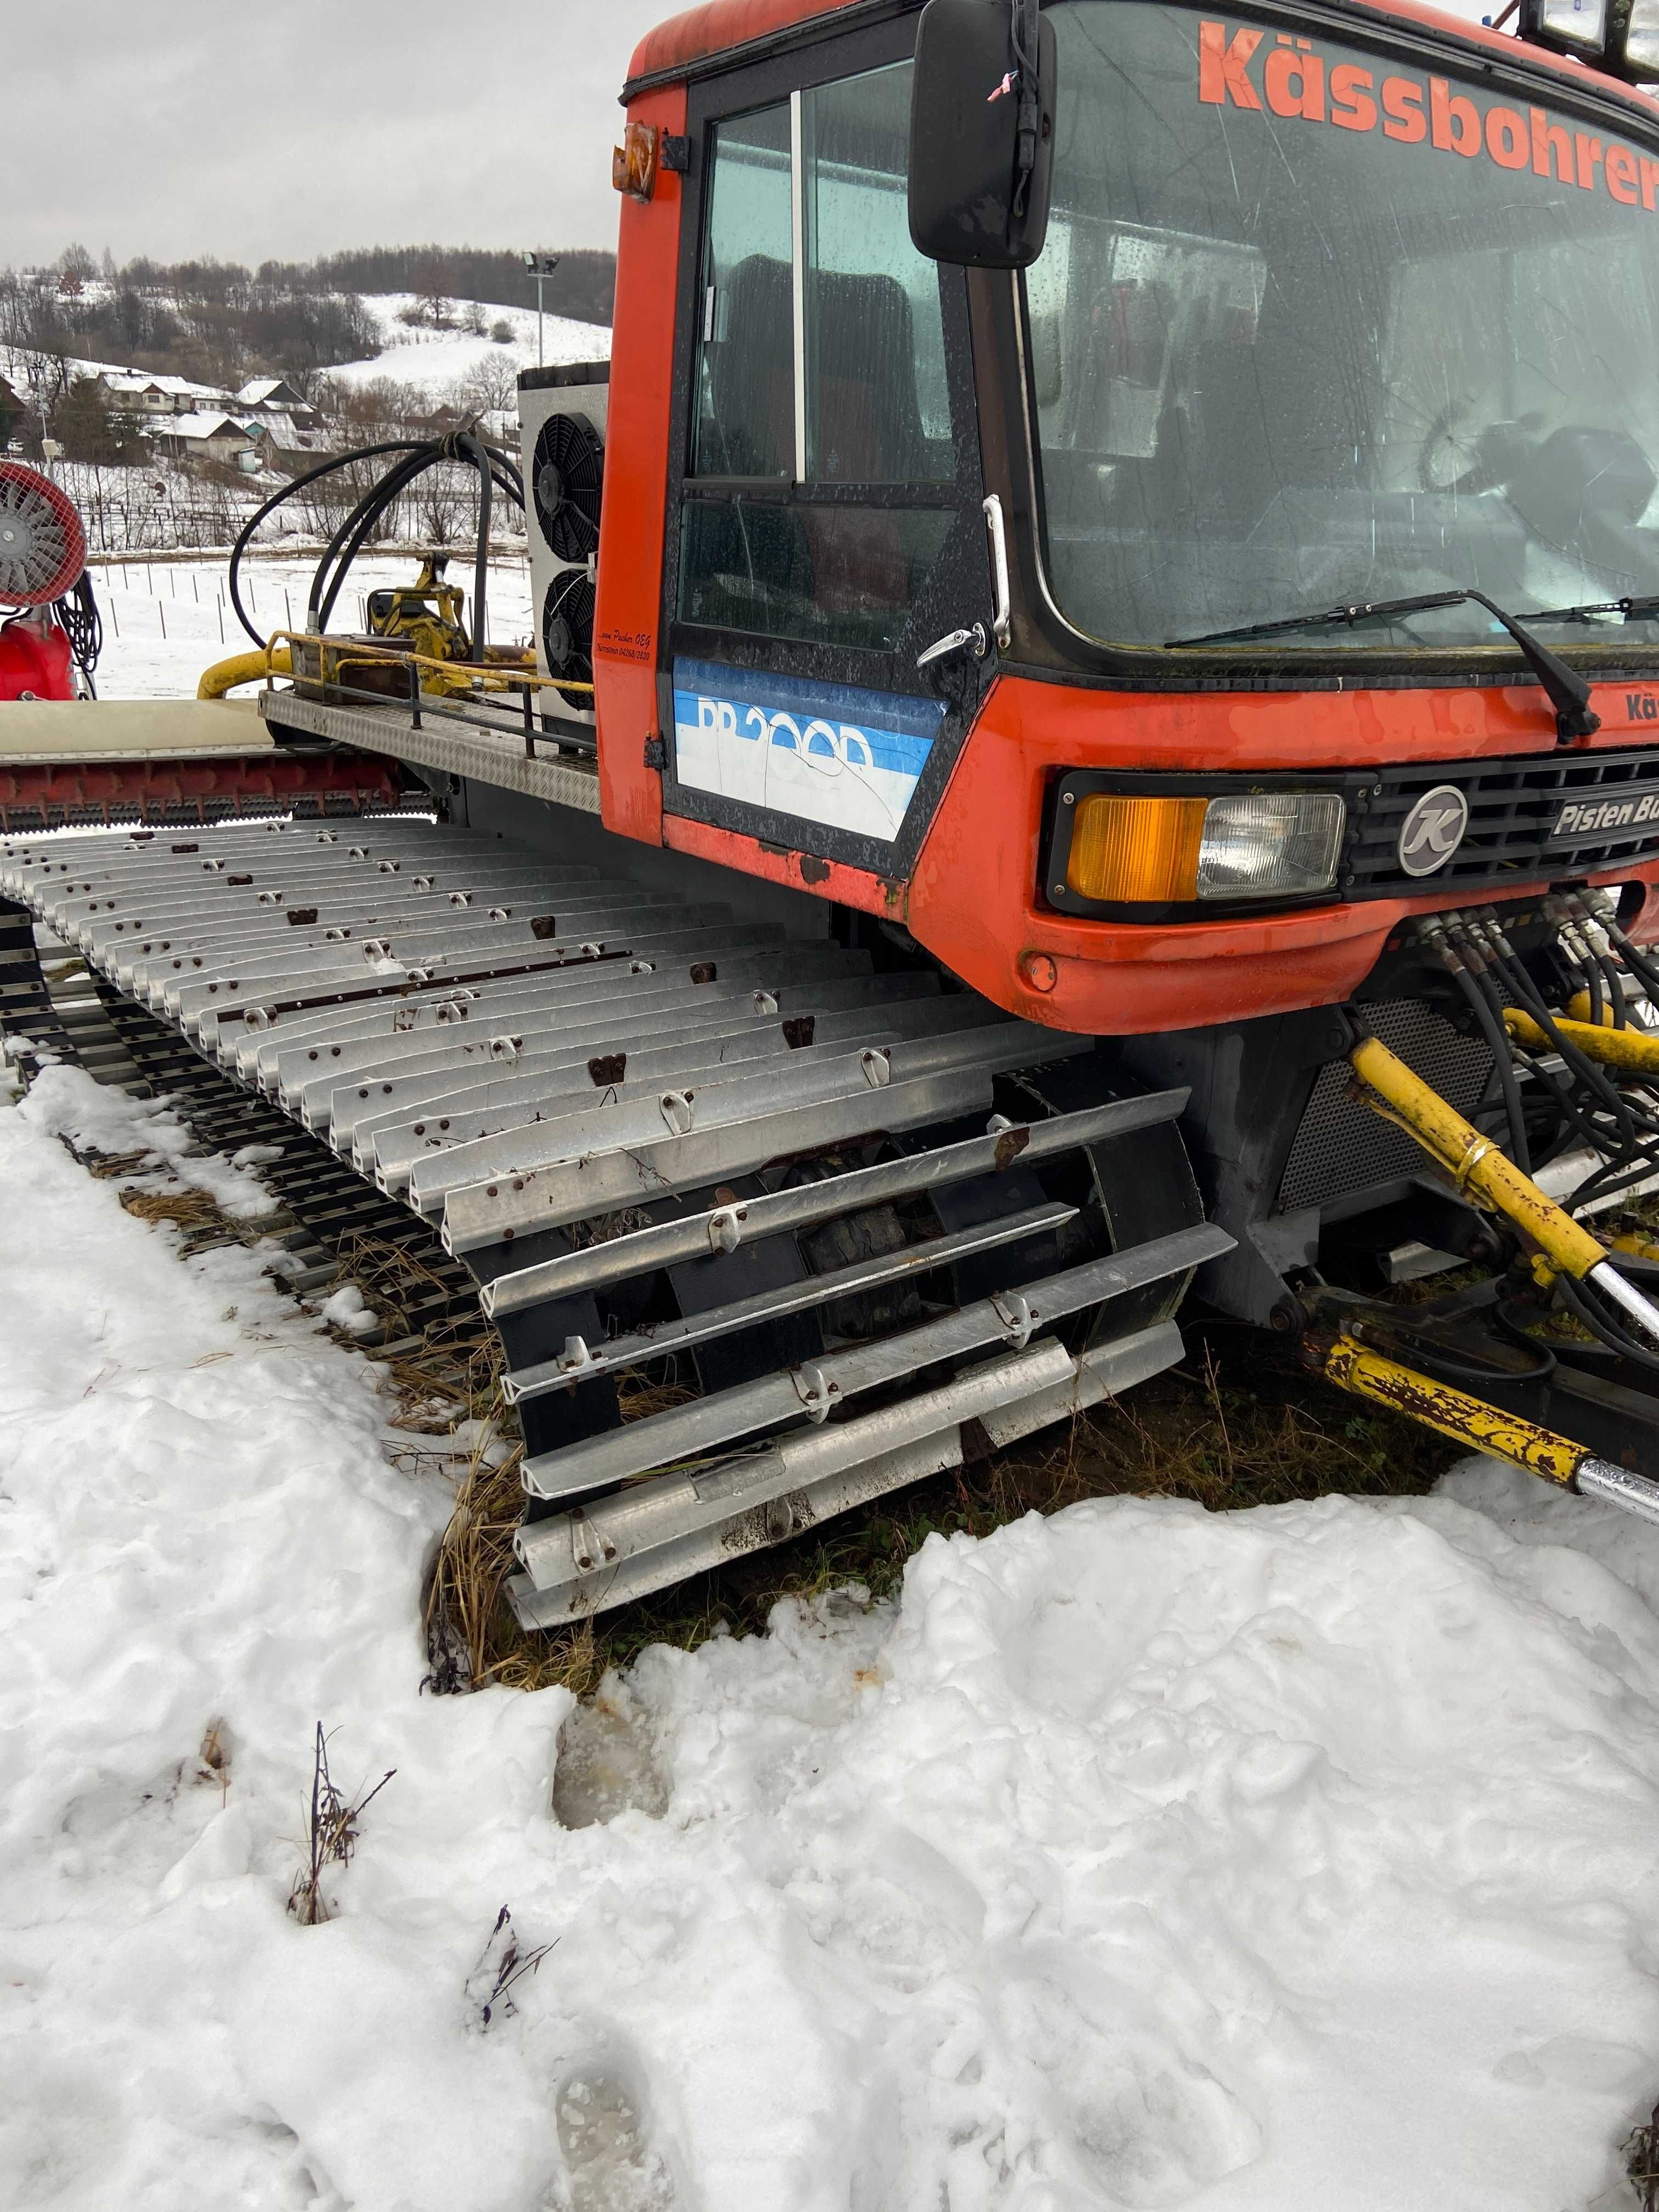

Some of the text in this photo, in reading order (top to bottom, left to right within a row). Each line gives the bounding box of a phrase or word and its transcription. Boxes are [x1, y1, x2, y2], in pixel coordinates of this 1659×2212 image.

[1200, 21, 1659, 211] Kässbohrer
[635, 634, 651, 650] OEG
[1626, 693, 1659, 720] Kä
[1553, 802, 1634, 834] Pisten
